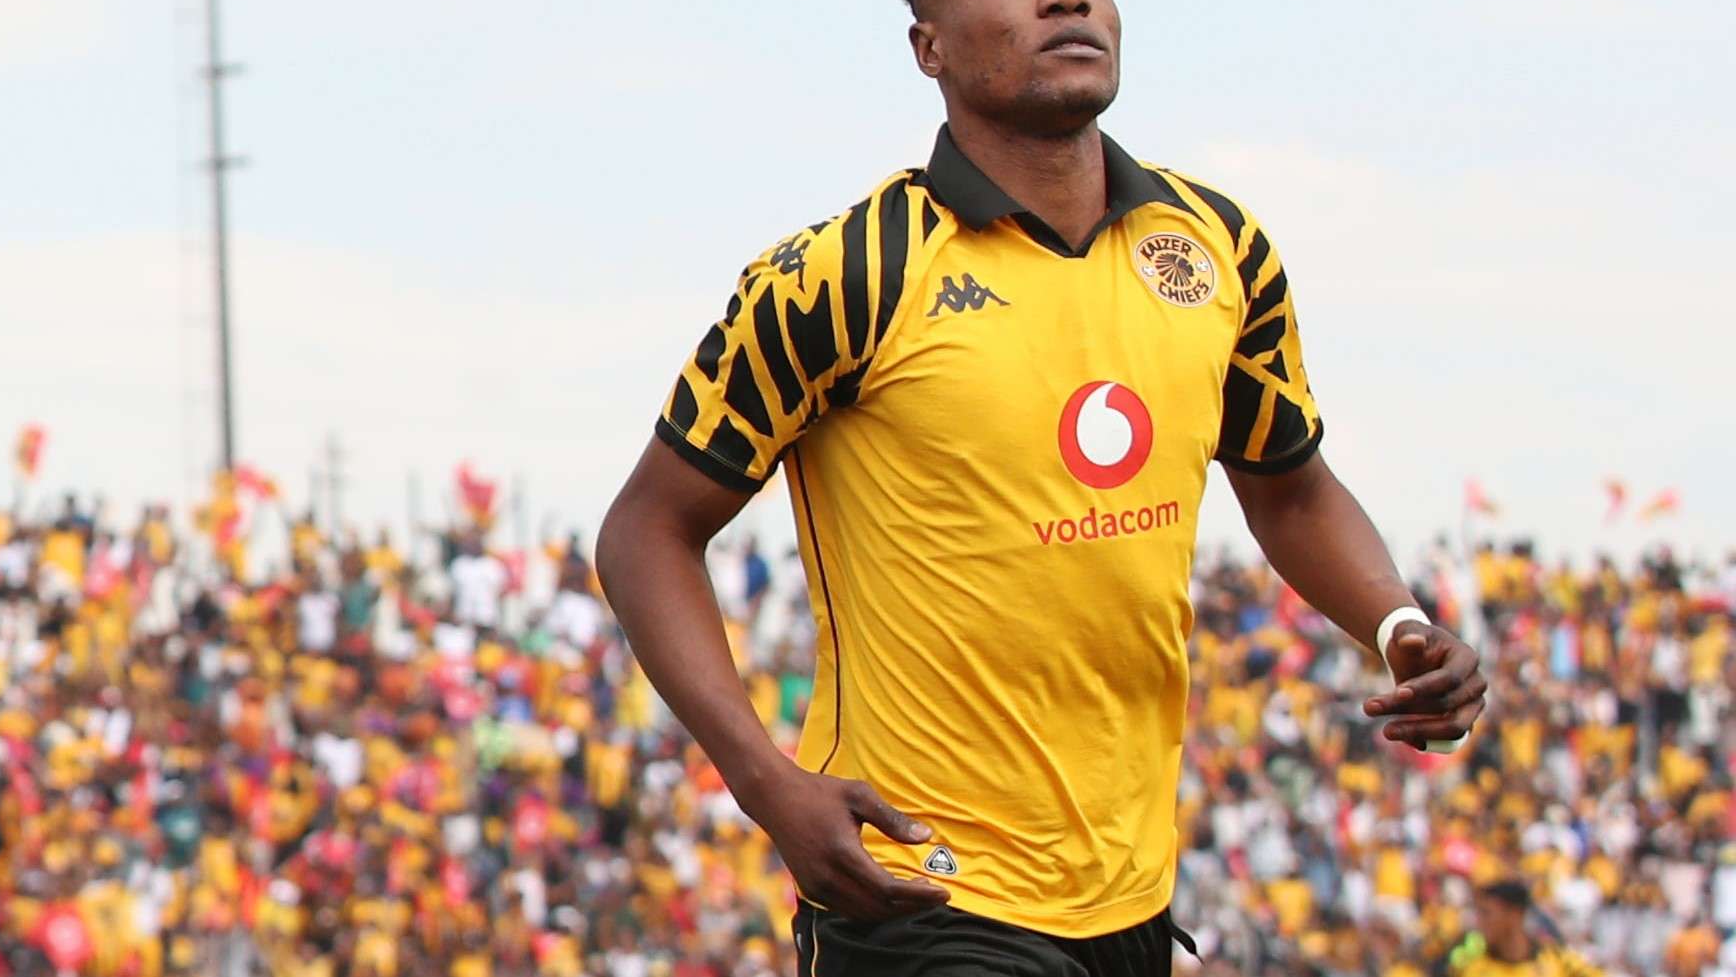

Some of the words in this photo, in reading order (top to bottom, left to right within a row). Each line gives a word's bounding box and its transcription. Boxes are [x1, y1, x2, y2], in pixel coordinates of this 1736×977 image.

[1140, 238, 1192, 261] KAIZER
[1157, 279, 1210, 303] CHIEFS
[1032, 501, 1179, 545] vodacom
